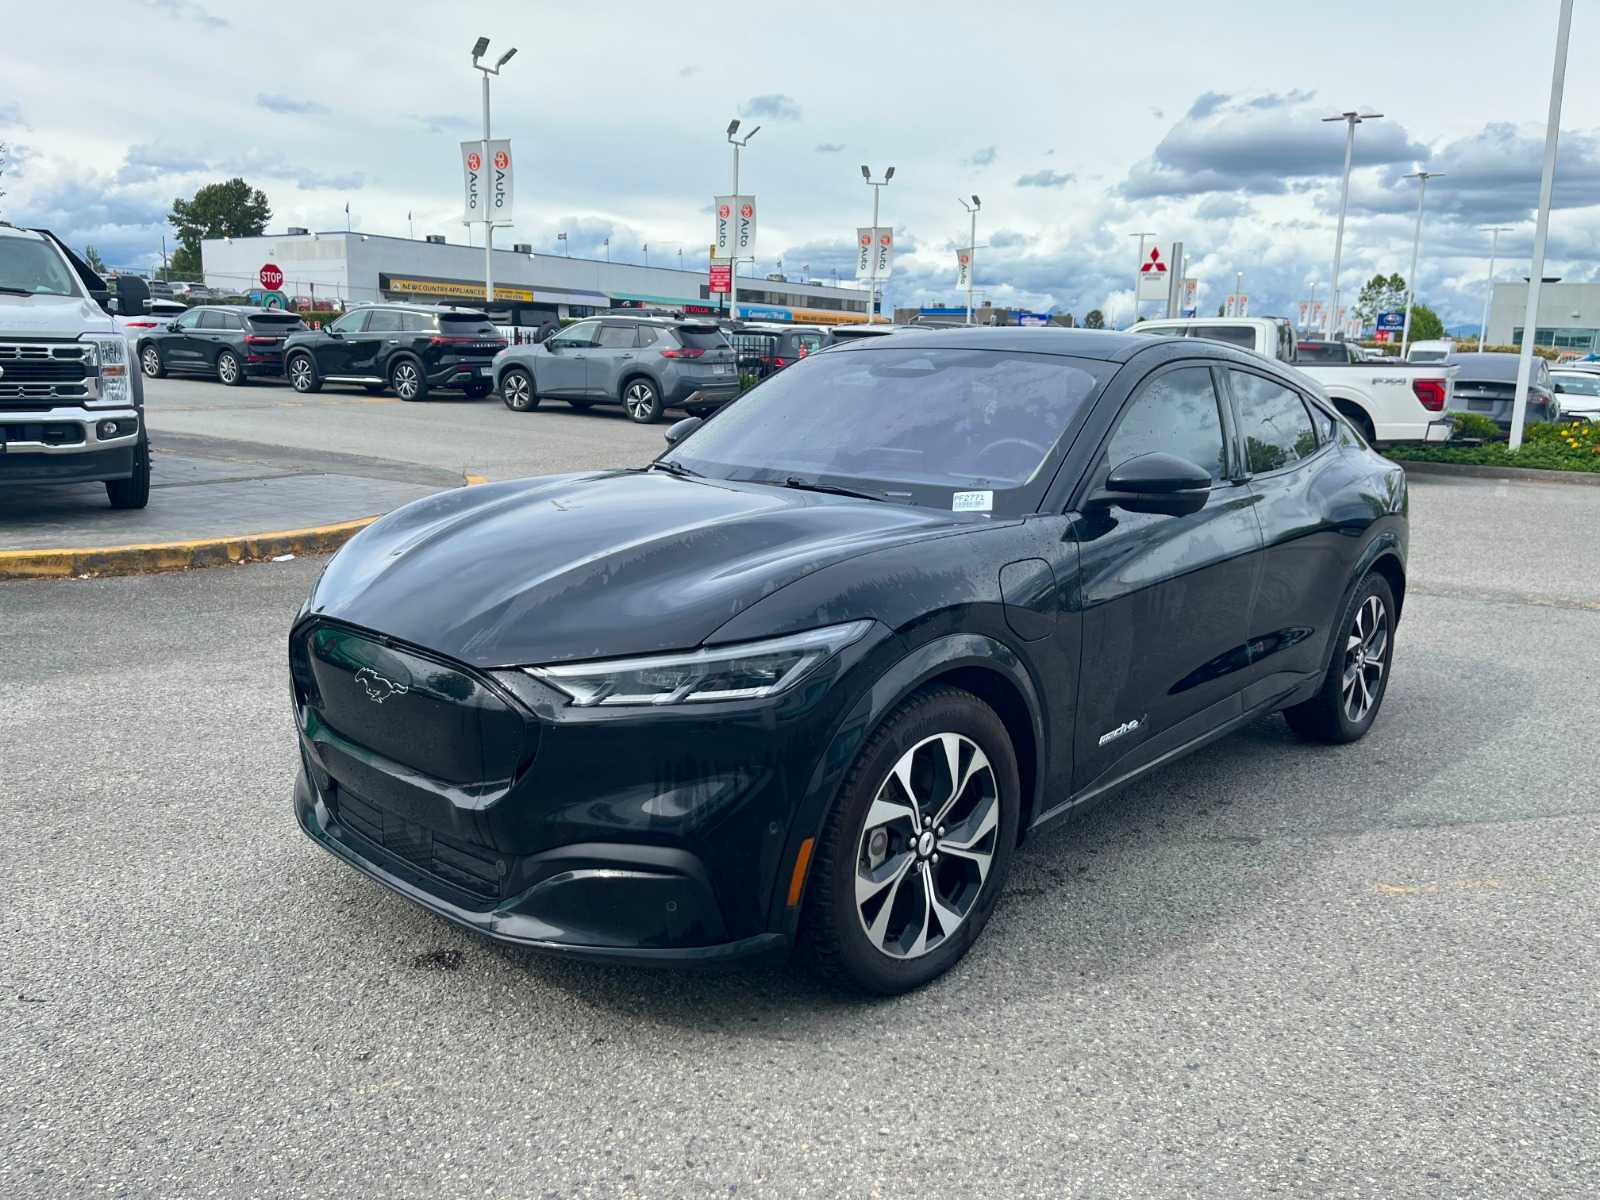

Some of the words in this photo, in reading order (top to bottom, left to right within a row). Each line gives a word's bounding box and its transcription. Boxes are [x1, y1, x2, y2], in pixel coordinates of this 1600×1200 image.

[469, 171, 478, 209] Auto
[496, 170, 505, 208] Auto
[740, 218, 750, 248] Auto
[861, 246, 869, 270] Auto
[261, 271, 282, 284] STOP
[402, 283, 417, 291] NEW
[418, 284, 448, 293] COUNTRY
